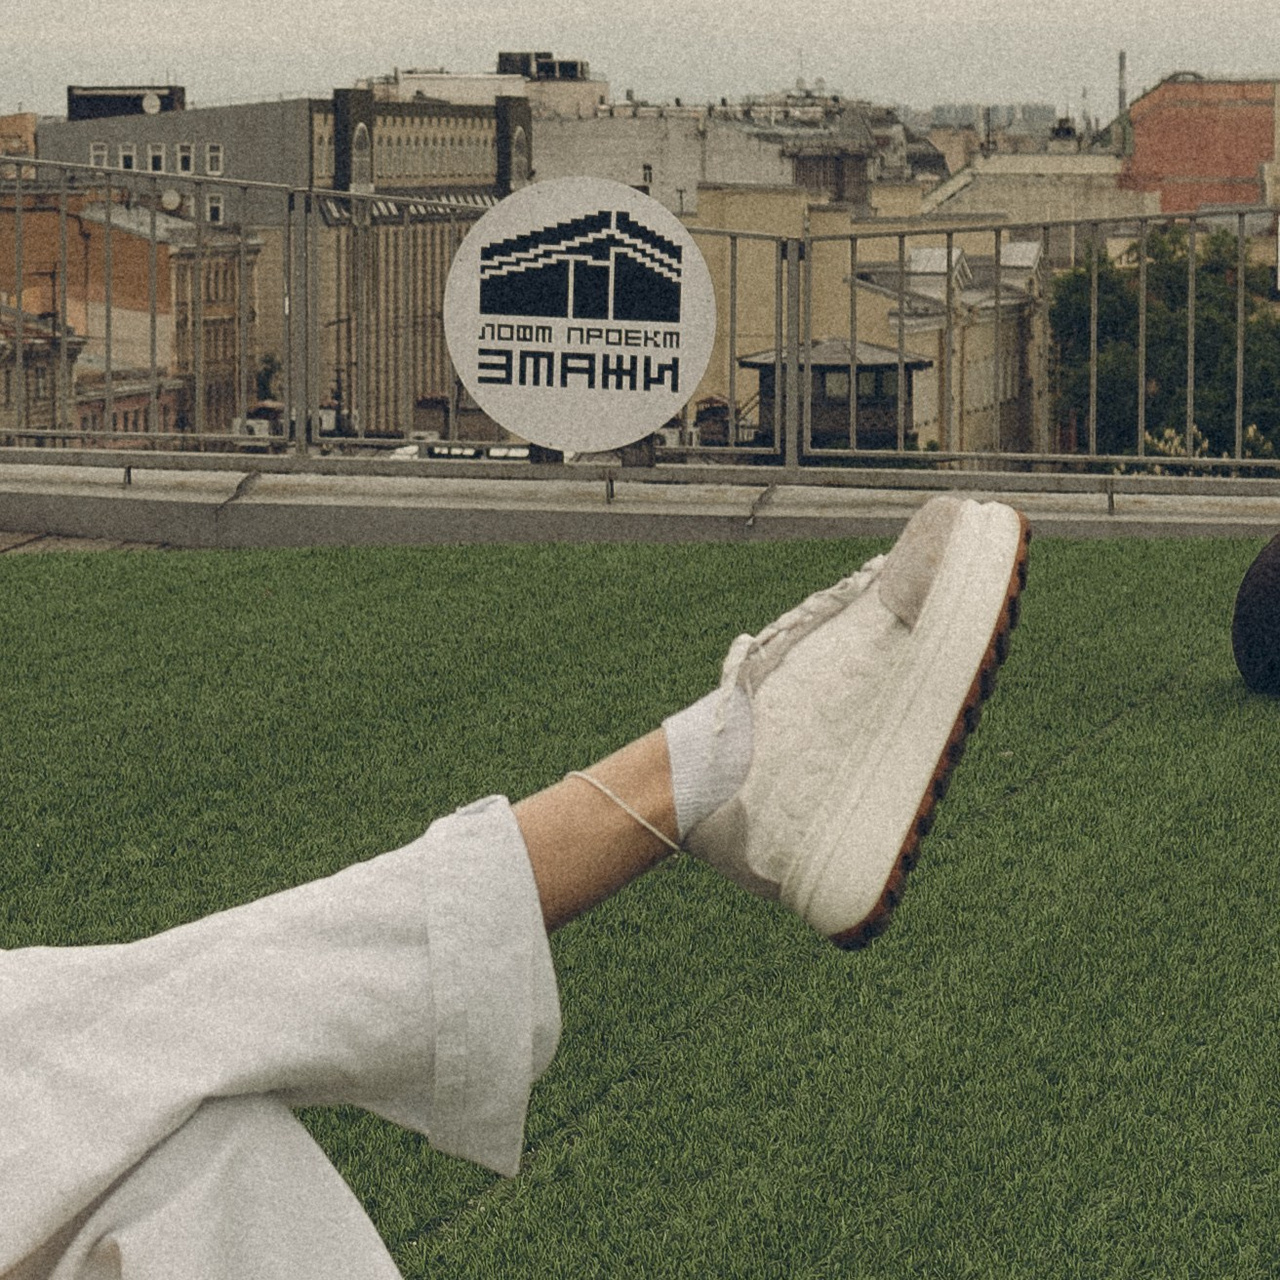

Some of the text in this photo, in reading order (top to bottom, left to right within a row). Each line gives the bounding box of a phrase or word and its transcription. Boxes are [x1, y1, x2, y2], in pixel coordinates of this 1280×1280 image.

[478, 323, 680, 349] ЛОФТ ПРОЕКТ
[477, 348, 680, 393] ЭТАЖИ
